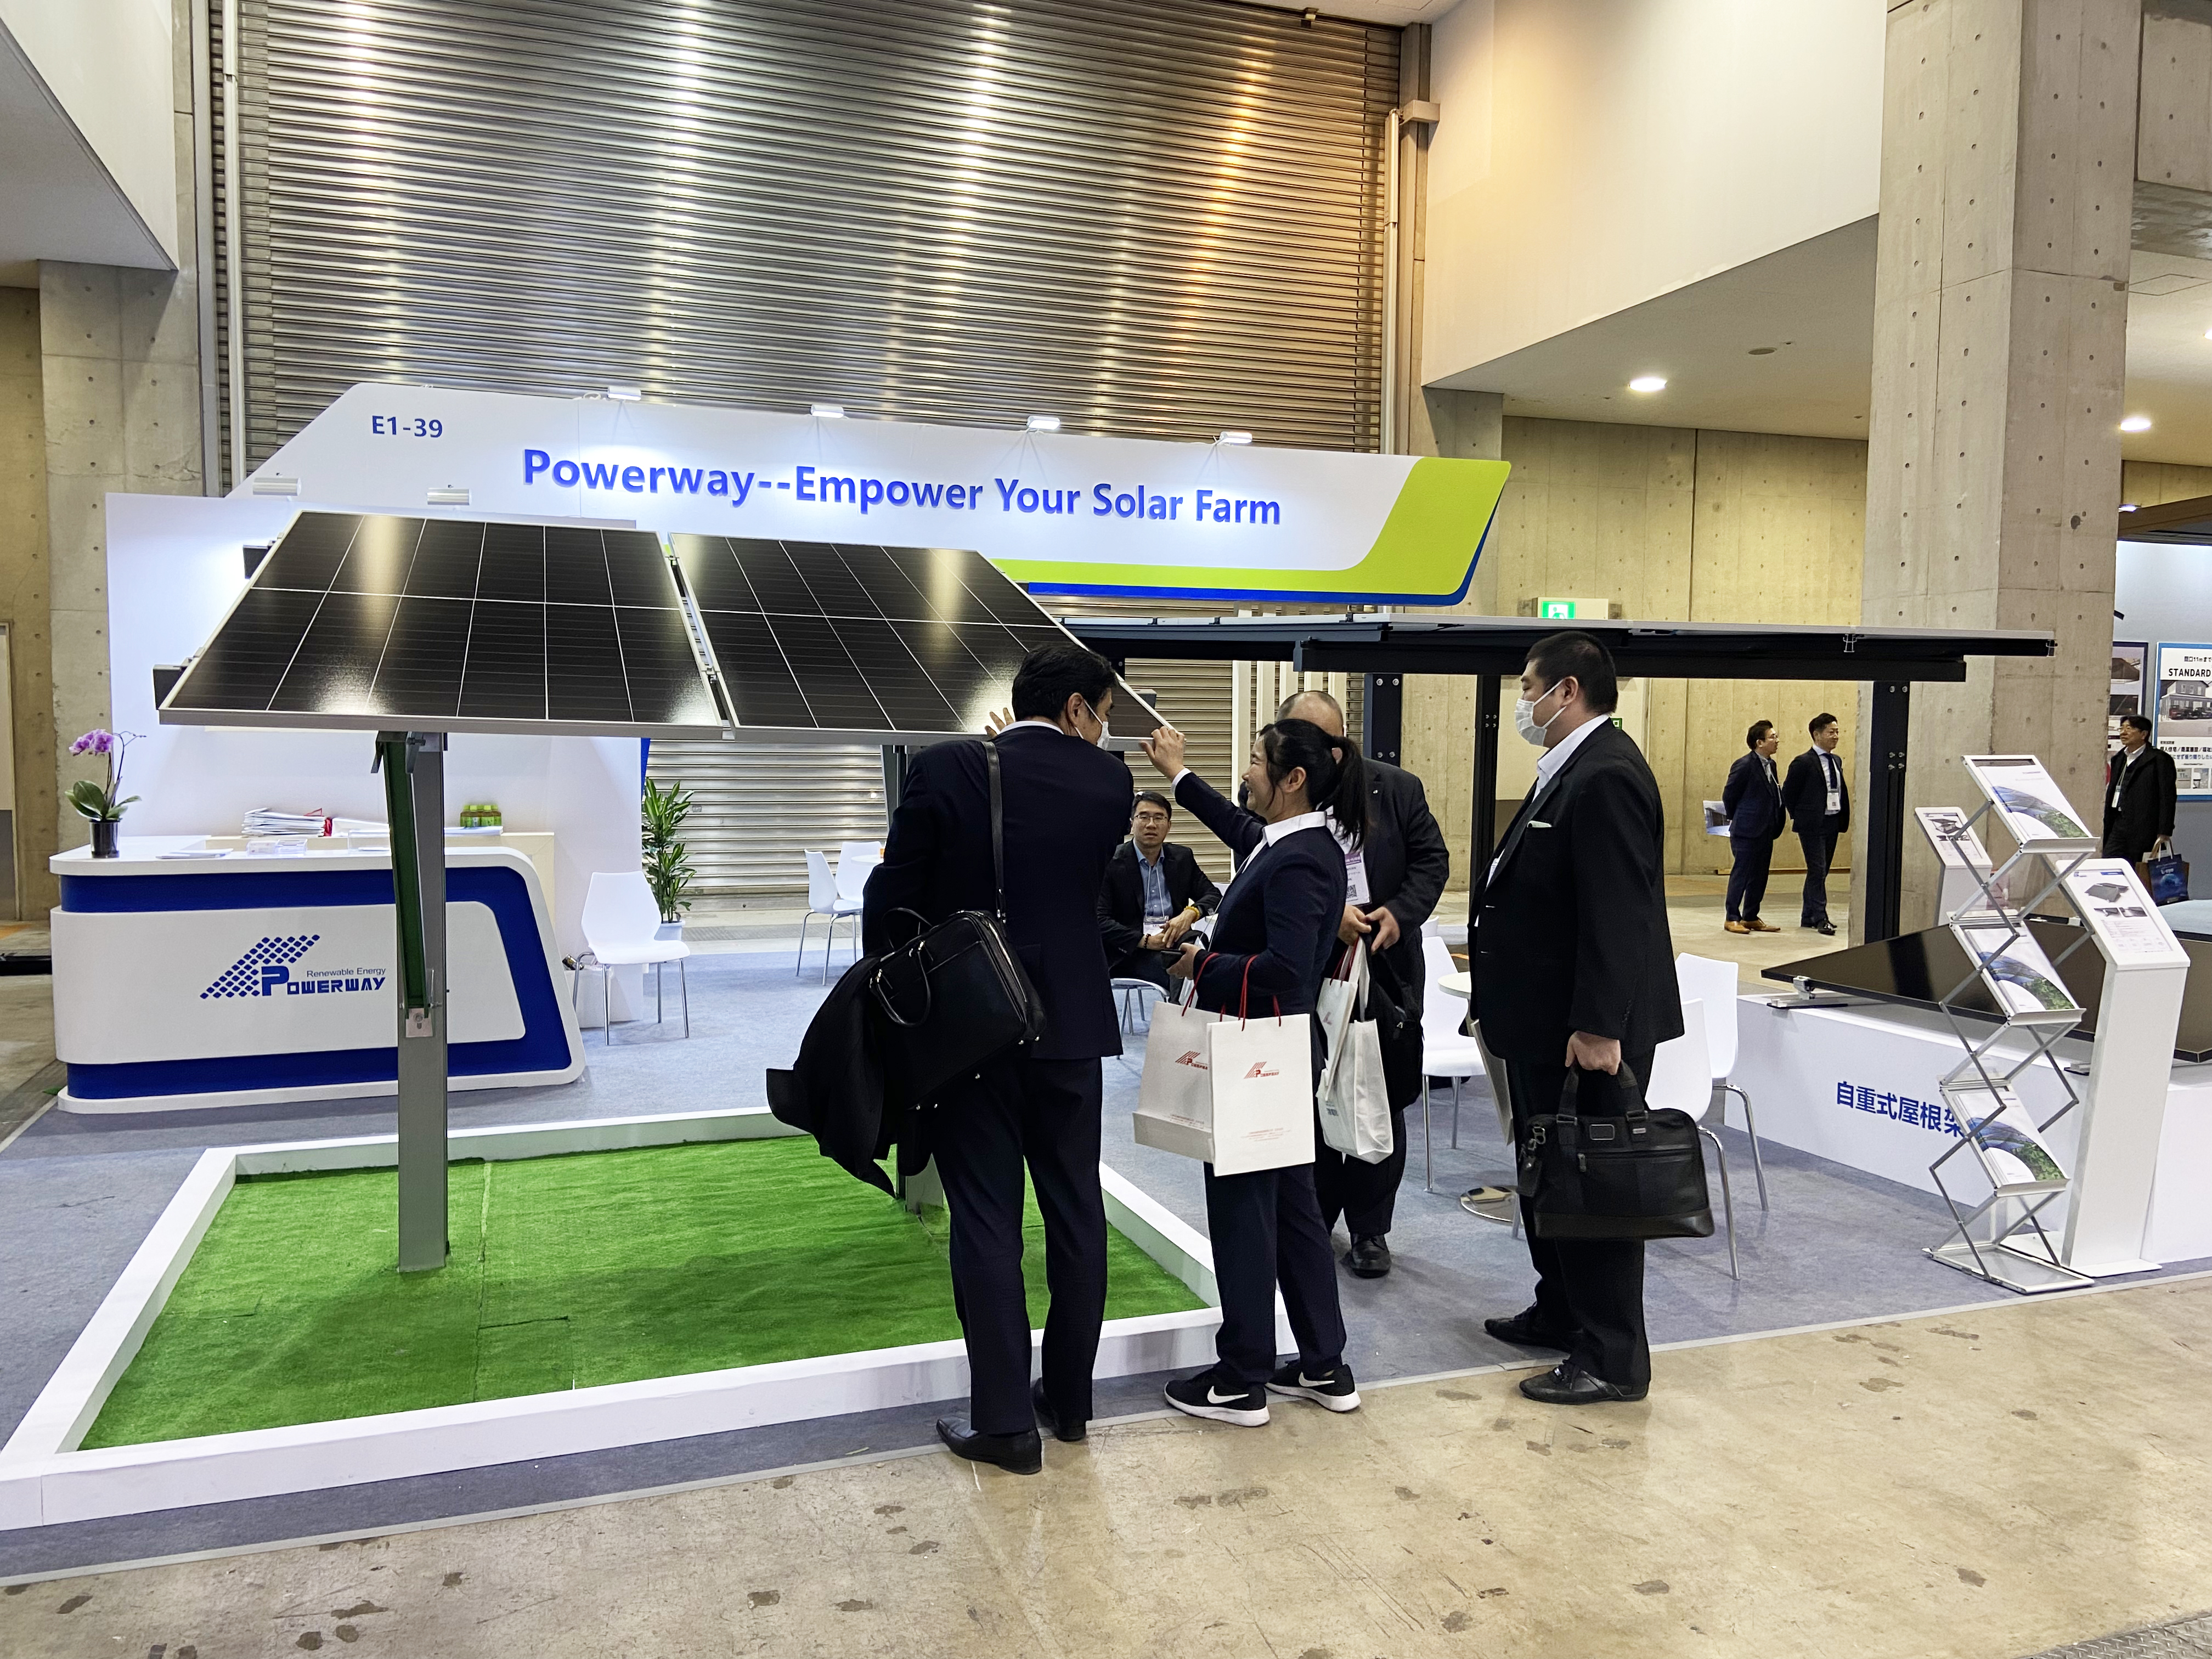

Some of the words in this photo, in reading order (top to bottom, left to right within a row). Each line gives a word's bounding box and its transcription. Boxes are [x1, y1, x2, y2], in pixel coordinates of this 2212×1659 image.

[373, 415, 443, 439] E1-39
[994, 477, 1081, 515] Your
[1093, 483, 1184, 521] Solar
[1195, 488, 1281, 526] Farm
[2168, 668, 2211, 677] STANDARD
[307, 968, 354, 978] Renewable
[357, 967, 386, 977] Energy
